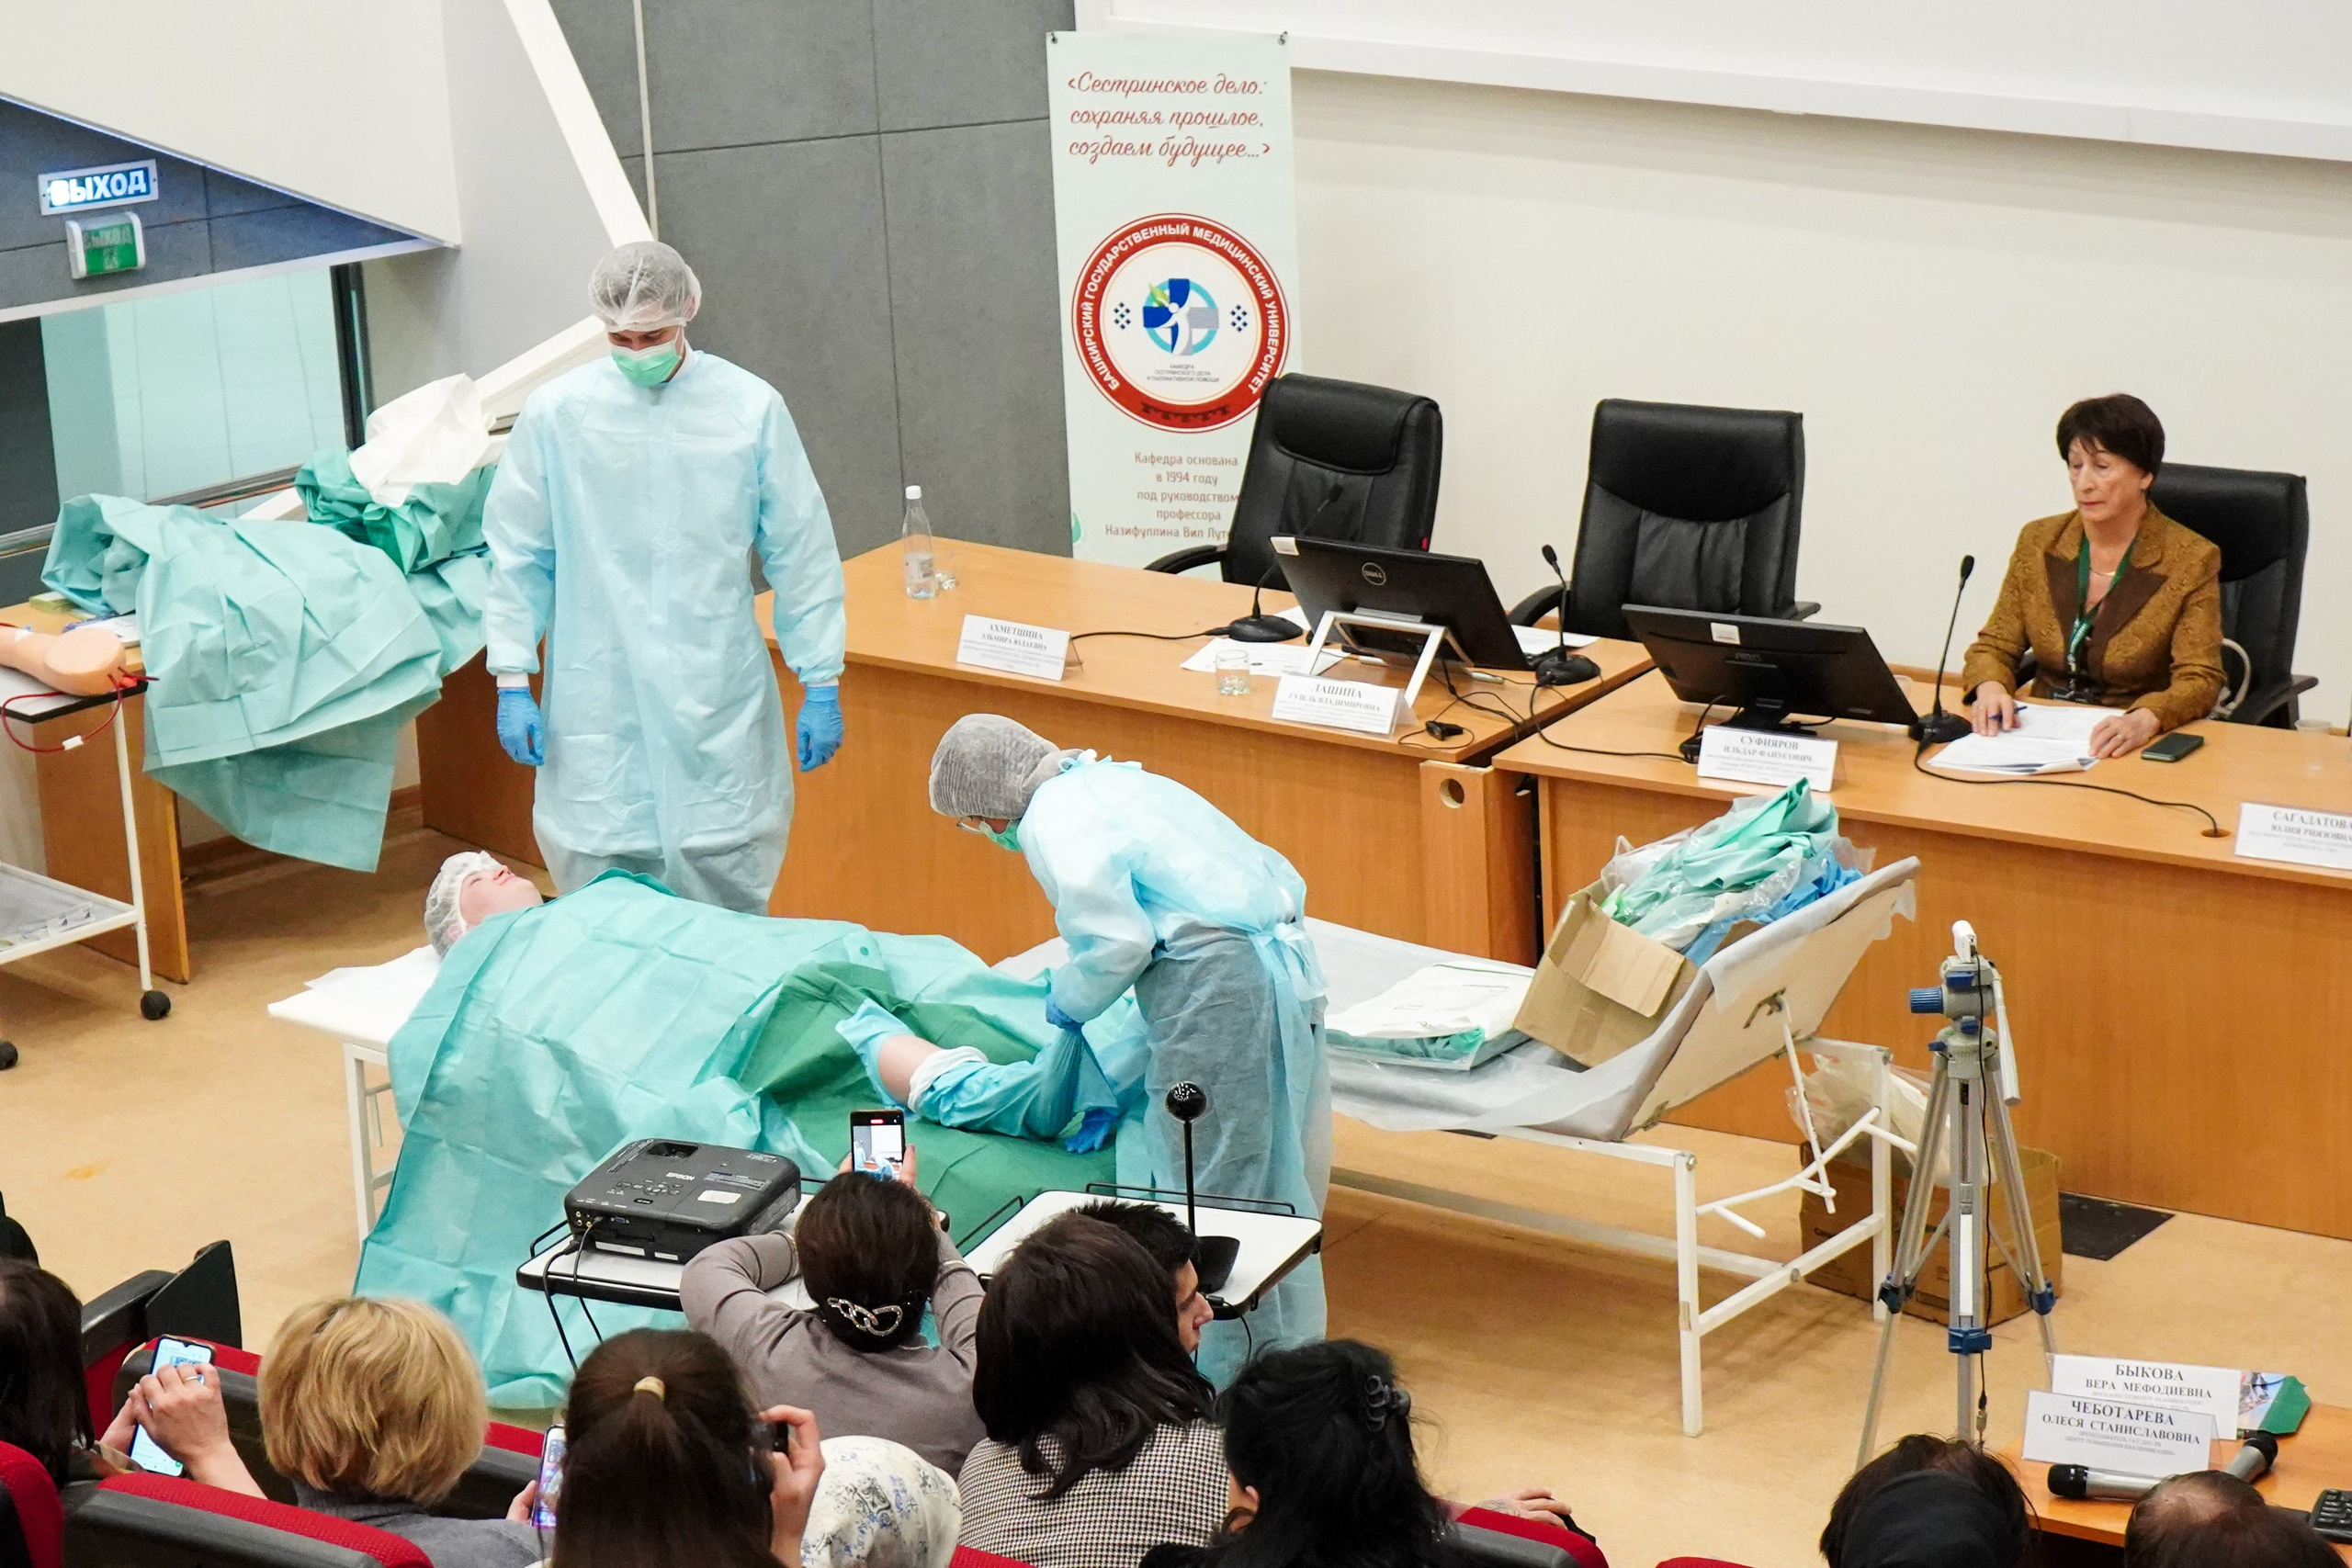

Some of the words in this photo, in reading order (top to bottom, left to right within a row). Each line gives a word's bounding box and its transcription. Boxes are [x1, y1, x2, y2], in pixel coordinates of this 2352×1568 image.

[1214, 73, 1267, 95] дело:
[1070, 109, 1163, 129] сохраняя
[1069, 135, 1152, 164] создаем
[50, 170, 147, 207] ВЫХОД
[1085, 223, 1190, 299] ГОСУДАРСТВЕННЫЙ
[1193, 226, 1274, 299] МЕДИЦИНСКИЙ
[1080, 301, 1121, 391] БАШКИРСКИЙ
[1248, 300, 1280, 394] УНИВЕРСИТЕТ
[1135, 452, 1182, 466] Кафедра
[1187, 455, 1238, 466] основана
[1156, 474, 1162, 482] в
[1167, 471, 1190, 483] 1994
[1193, 474, 1218, 486] году
[1137, 491, 1158, 502] под
[1161, 491, 1239, 503] руководством
[1157, 508, 1221, 522] профессора
[1105, 525, 1180, 538] Назифуллина
[1183, 526, 1204, 538] Вил
[1740, 736, 1799, 750] СУФИЯРОВ
[665, 1171, 695, 1181] EPSON
[2116, 1364, 2184, 1382] БЫКОВА
[2086, 1379, 2116, 1390] ВЕРА
[2123, 1382, 2212, 1398] МЕФОДИЕВНА
[2072, 1400, 2175, 1426] ЧЕБОТАРЕВА
[2042, 1414, 2084, 1428] ОЛЕСЯ
[2090, 1420, 2200, 1444] СТАНИСЛАВОВНА
